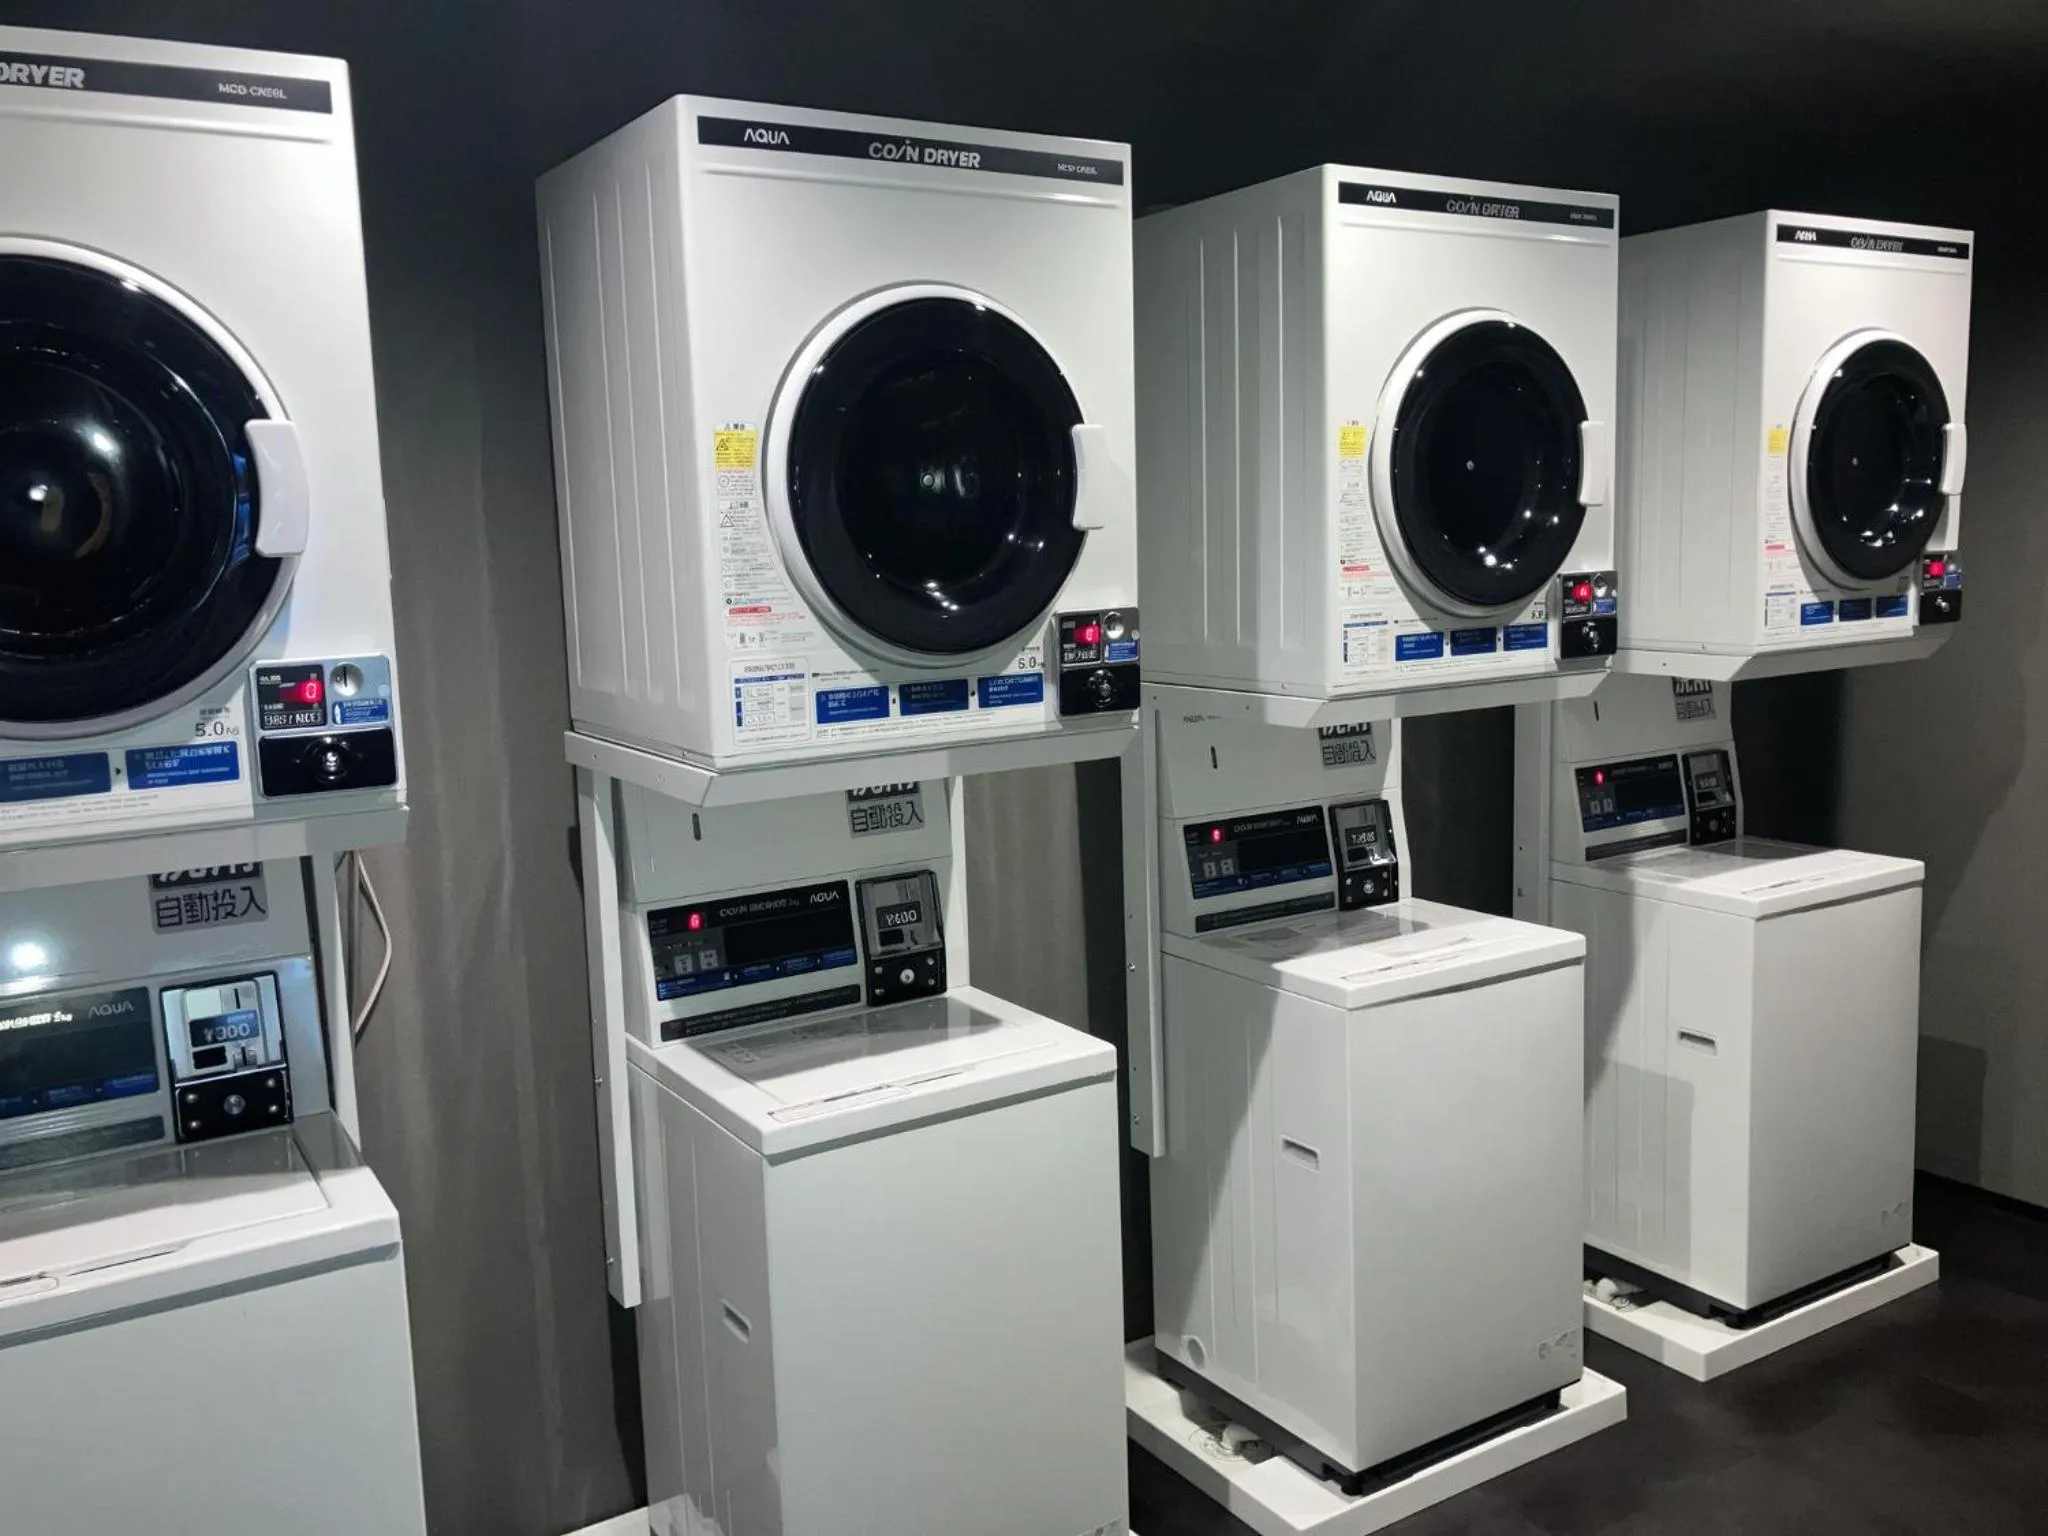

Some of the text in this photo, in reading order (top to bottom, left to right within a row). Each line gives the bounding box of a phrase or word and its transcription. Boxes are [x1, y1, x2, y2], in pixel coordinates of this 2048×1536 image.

[744, 128, 790, 146] AQUA
[923, 148, 981, 169] DRYER
[1366, 189, 1397, 204] AQUA
[155, 886, 267, 928] 自動投入
[88, 1000, 135, 1018] AQUA
